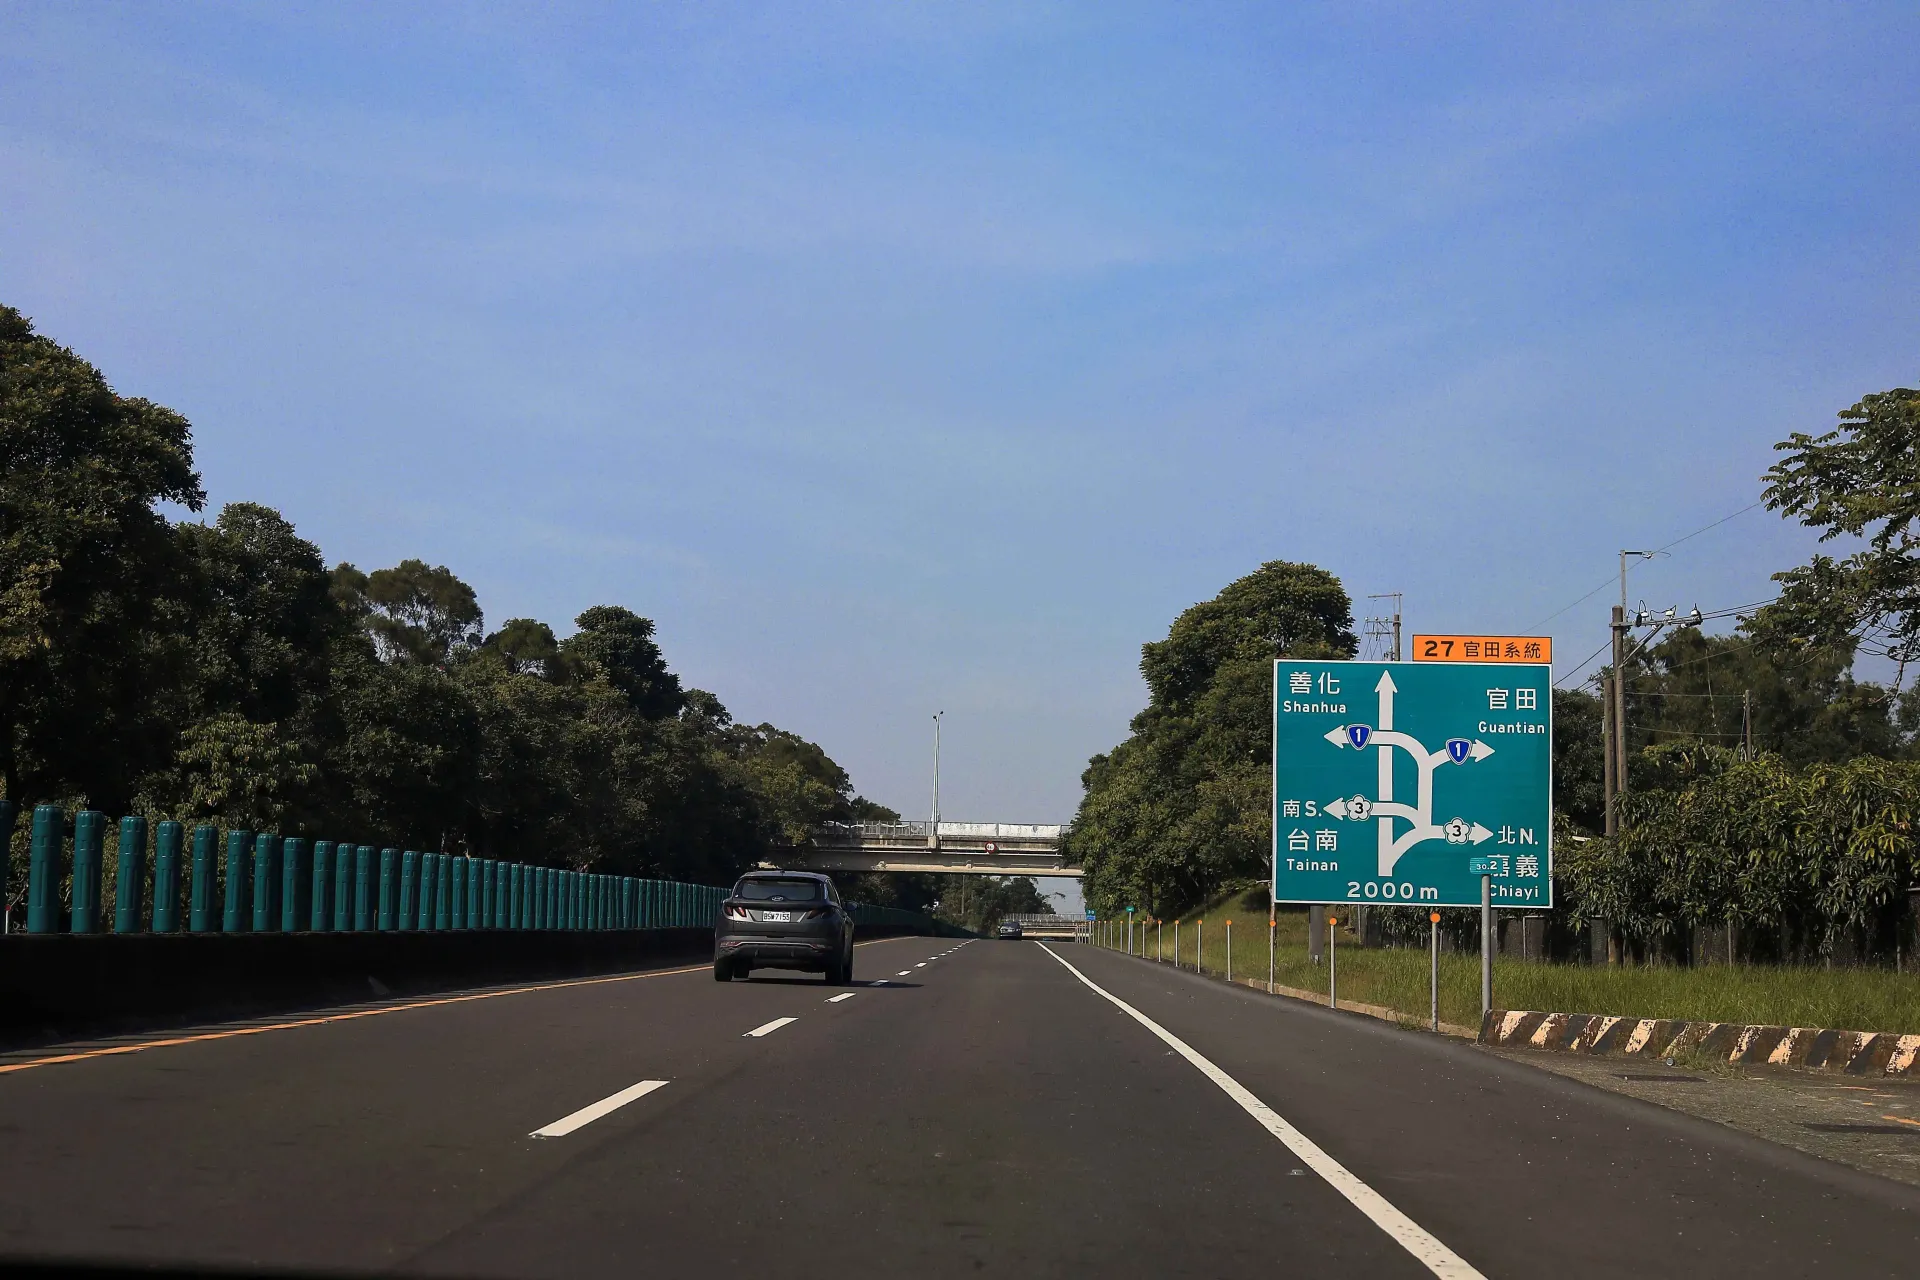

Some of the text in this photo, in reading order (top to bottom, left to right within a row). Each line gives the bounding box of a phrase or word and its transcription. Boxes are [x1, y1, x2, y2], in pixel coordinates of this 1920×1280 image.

[1424, 640, 1541, 659] 27 官田系統
[1289, 671, 1340, 695] 善化
[1486, 687, 1537, 711] 官田
[1283, 700, 1347, 714] Shanhua
[1355, 728, 1361, 742] 1
[1478, 720, 1545, 735] Guantian
[1455, 742, 1461, 757] 1
[1282, 799, 1322, 818] 南 S.
[1354, 802, 1364, 814] 3
[1452, 825, 1462, 837] 3
[1497, 825, 1539, 845] 北 N.
[1287, 828, 1338, 852] 台南
[1286, 858, 1338, 871] Tainan
[1476, 860, 1498, 870] 30.2
